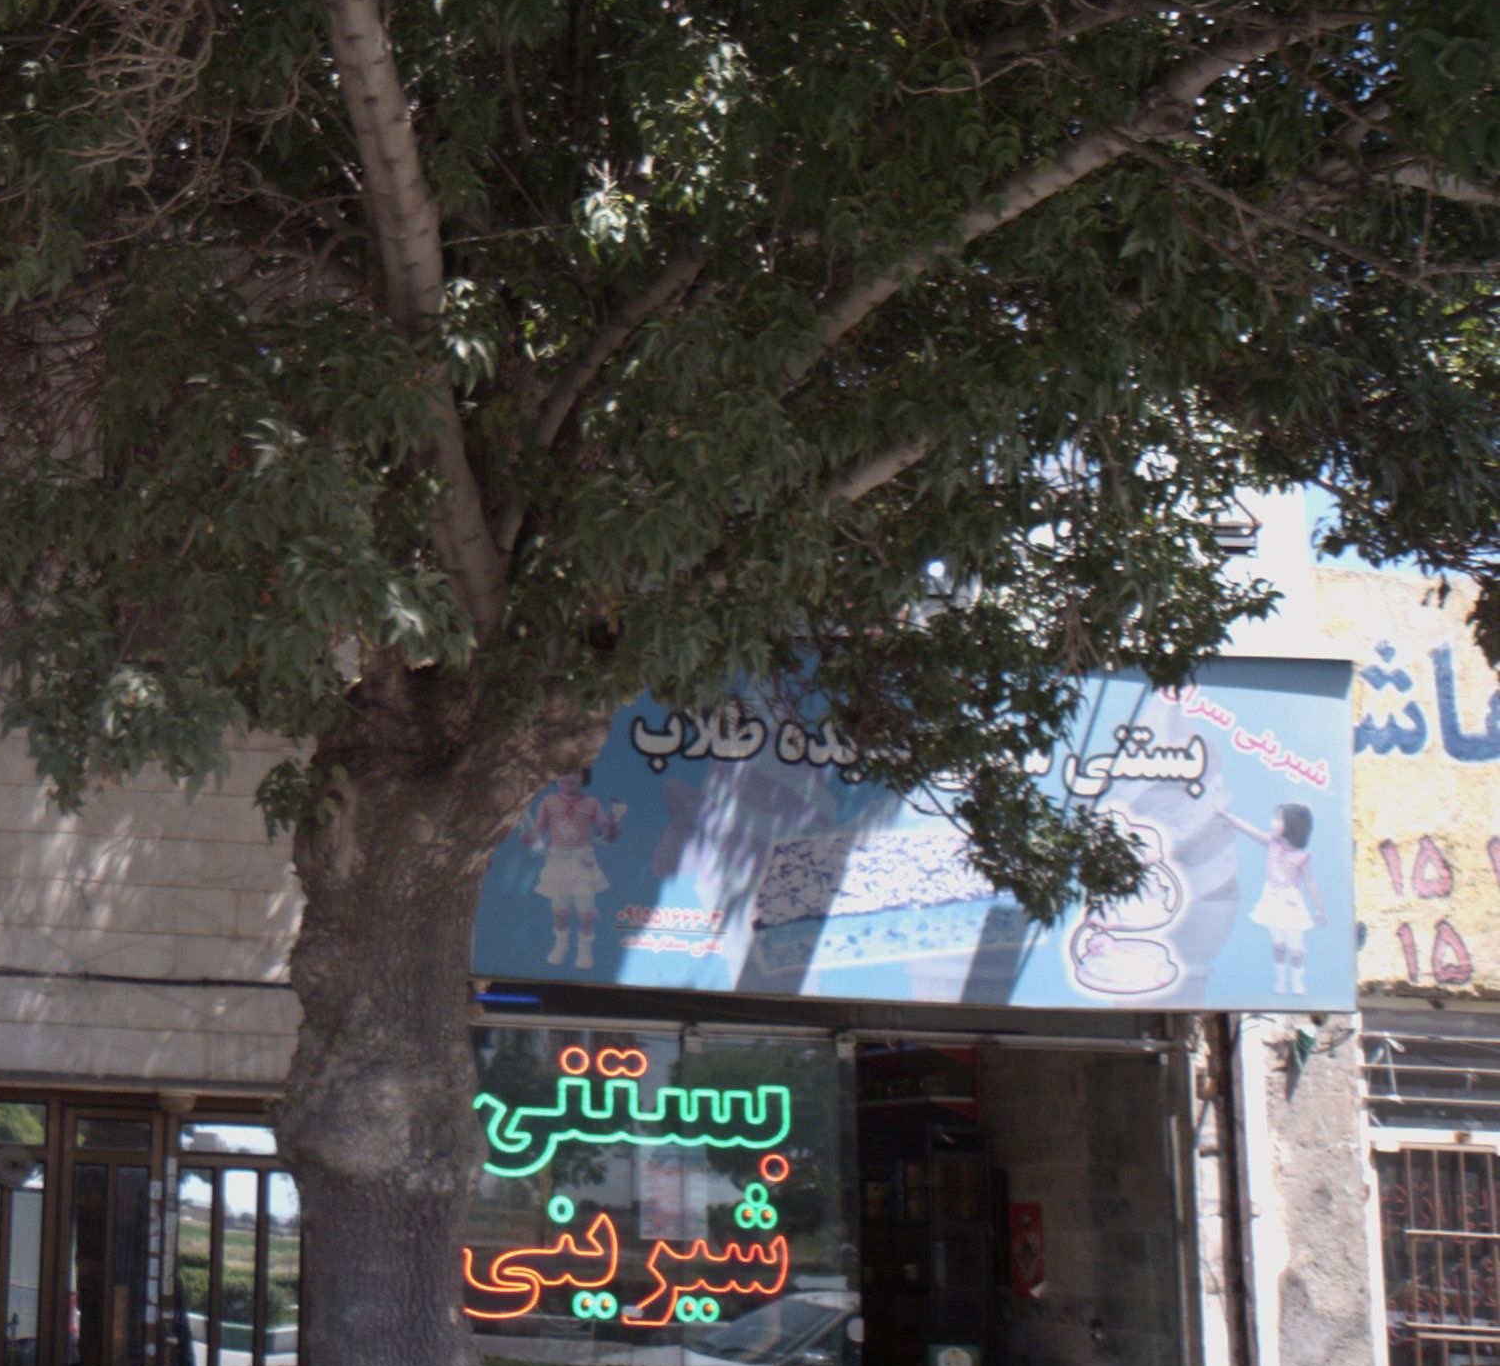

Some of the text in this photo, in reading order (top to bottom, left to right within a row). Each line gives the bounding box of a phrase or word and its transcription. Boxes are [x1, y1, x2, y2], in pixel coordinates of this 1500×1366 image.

[630, 697, 768, 775] طلاب
[1062, 723, 1208, 799] بستنی
[1233, 729, 1332, 790] شیرینی
[472, 1046, 791, 1183] بستنی
[463, 1181, 790, 1327] شیرینی
